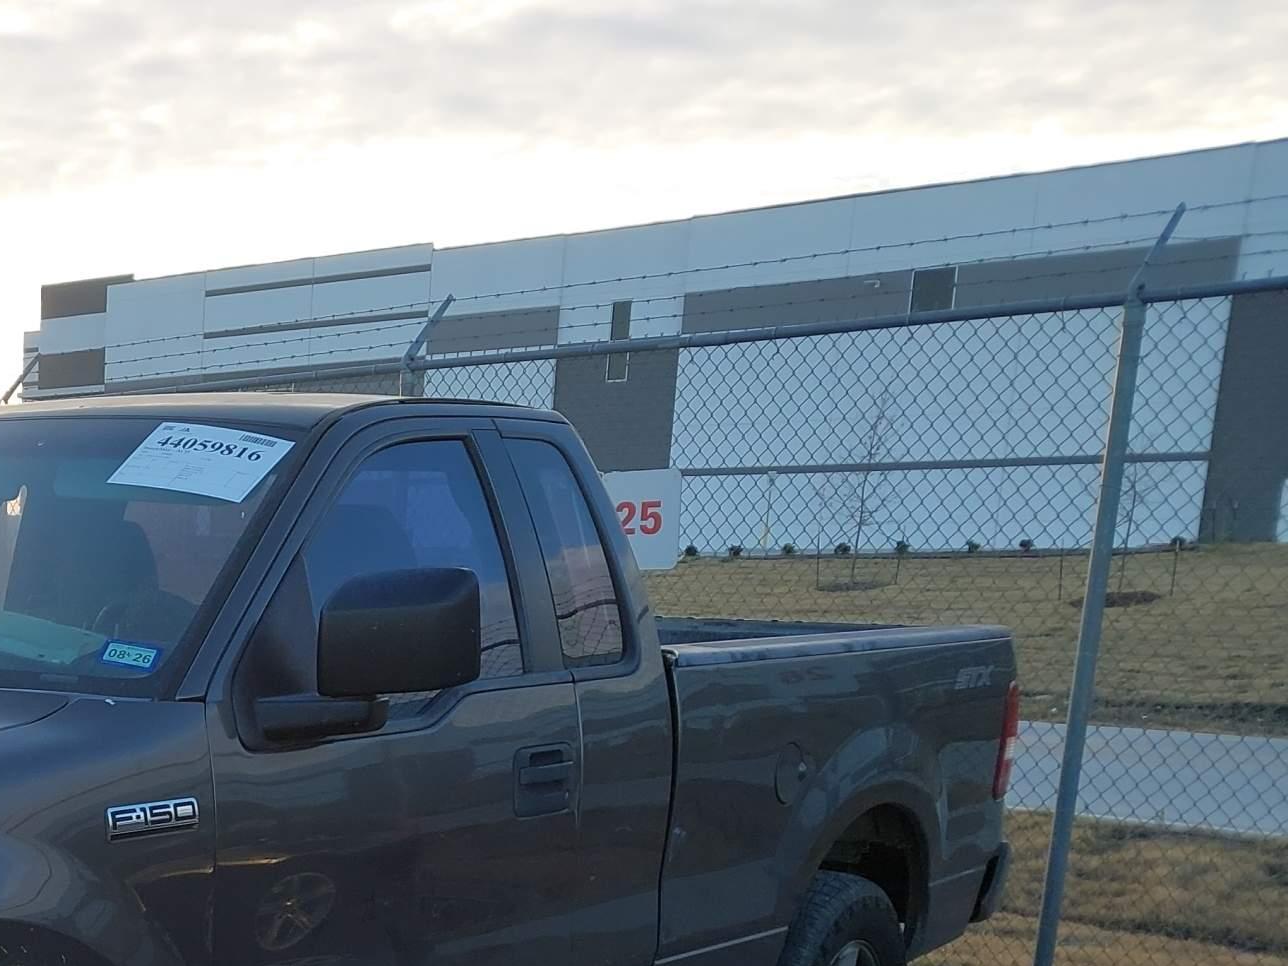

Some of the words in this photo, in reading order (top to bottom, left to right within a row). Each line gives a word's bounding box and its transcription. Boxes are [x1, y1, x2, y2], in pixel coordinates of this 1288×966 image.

[157, 435, 263, 462] 44059816
[616, 500, 663, 535] 25
[954, 665, 994, 690] STX
